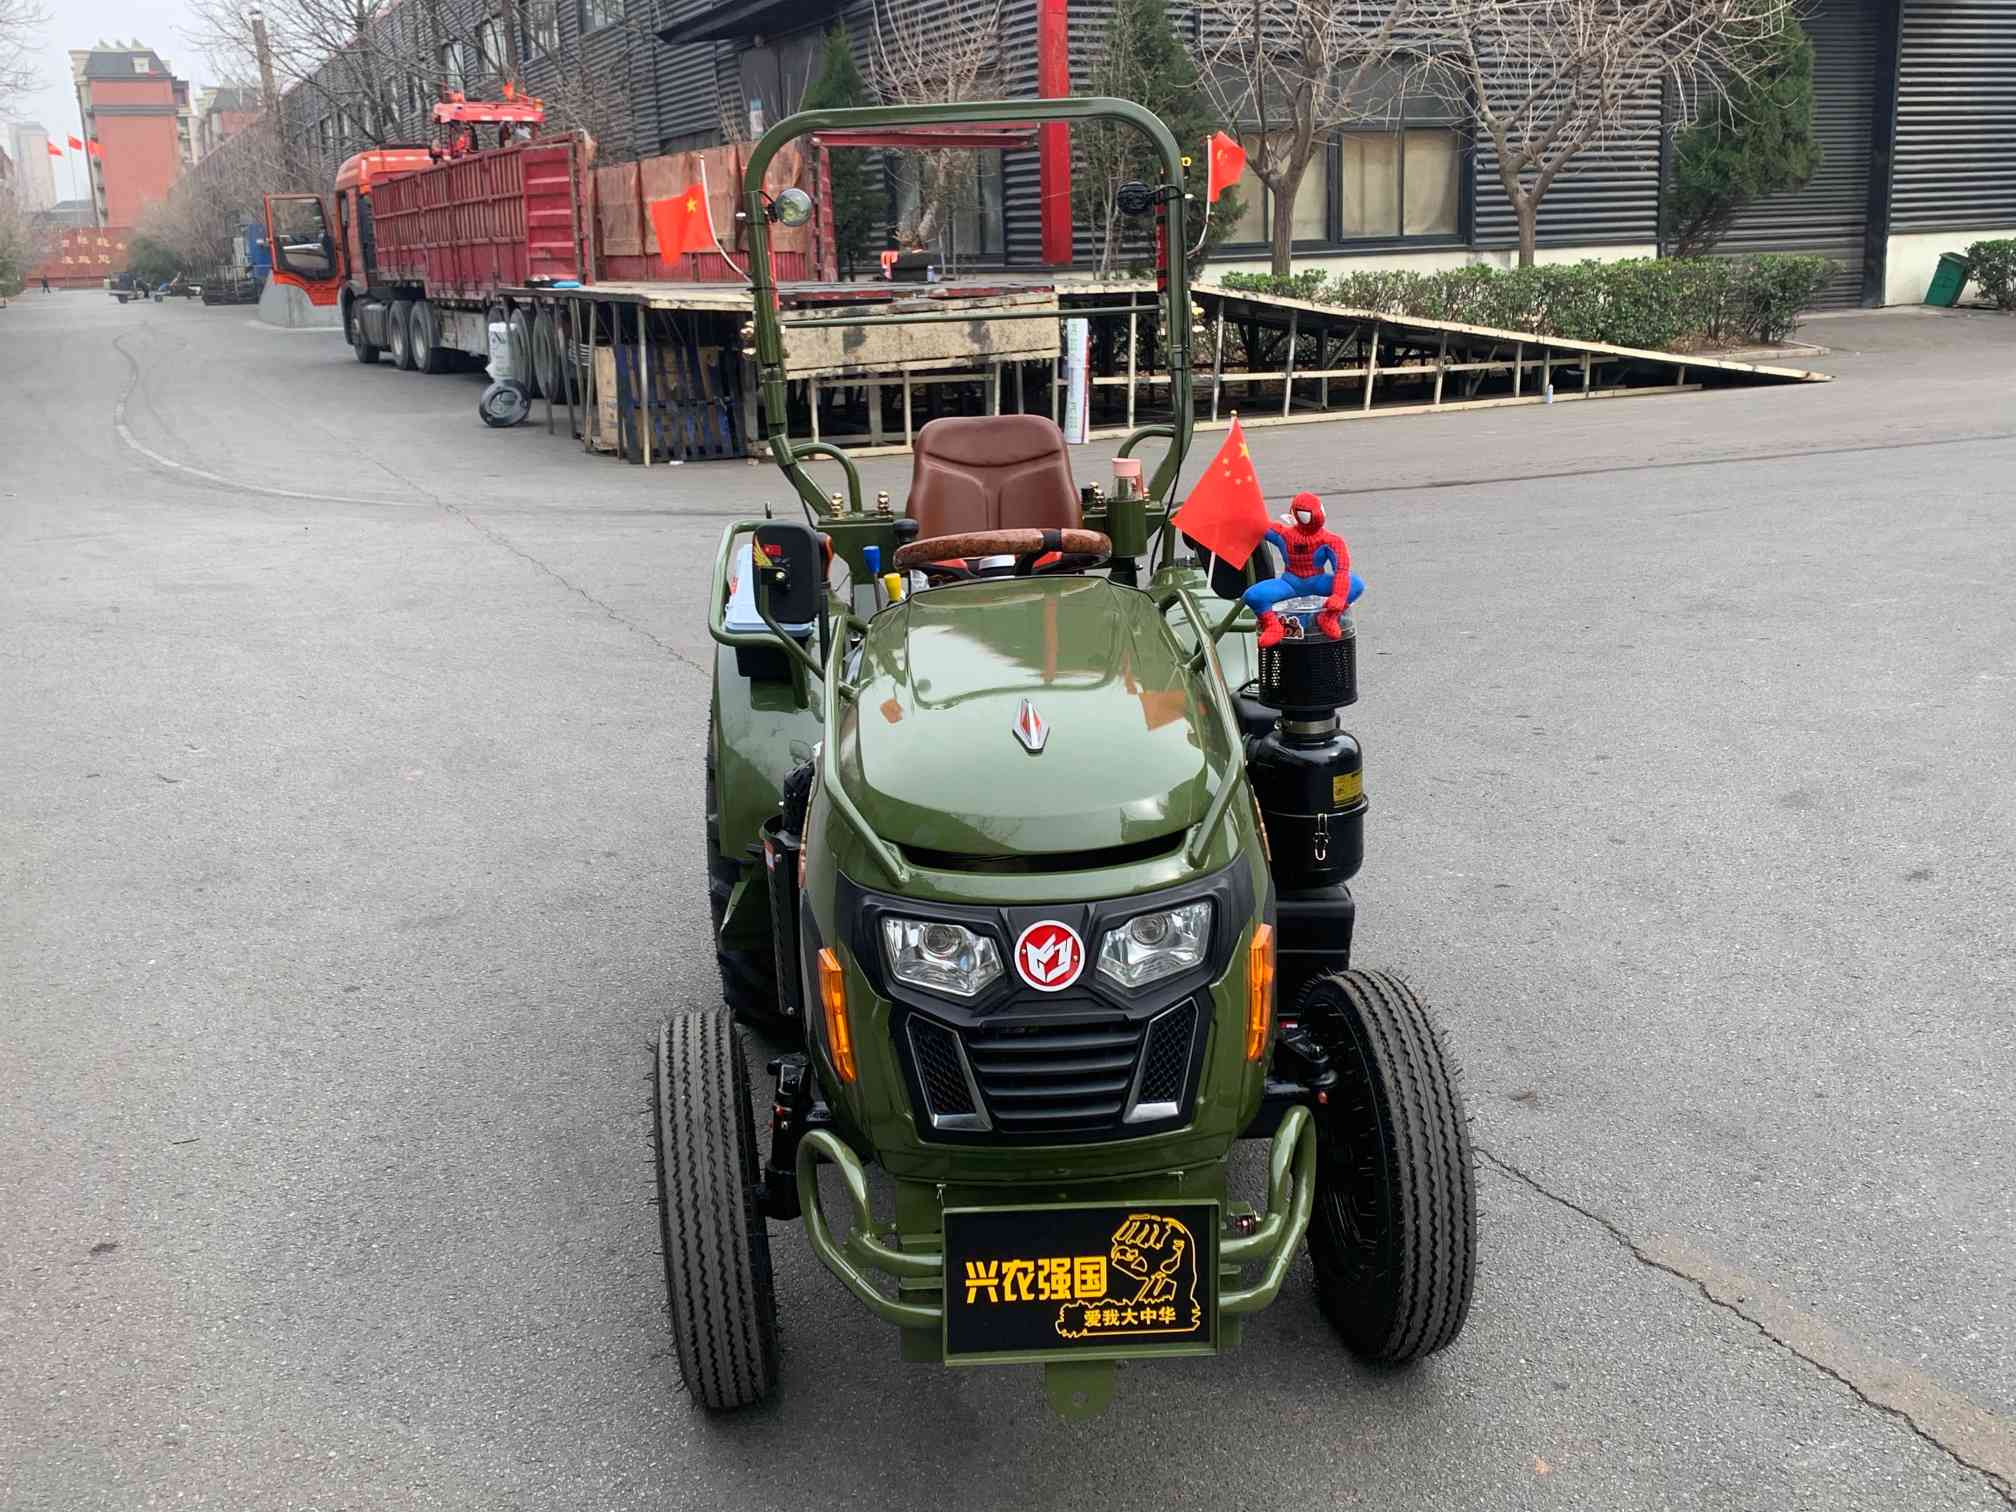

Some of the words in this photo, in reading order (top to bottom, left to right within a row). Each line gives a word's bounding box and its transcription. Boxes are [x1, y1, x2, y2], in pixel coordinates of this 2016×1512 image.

[965, 1255, 1107, 1304] 兴农强国
[1083, 1306, 1177, 1328] 爱我大中华
